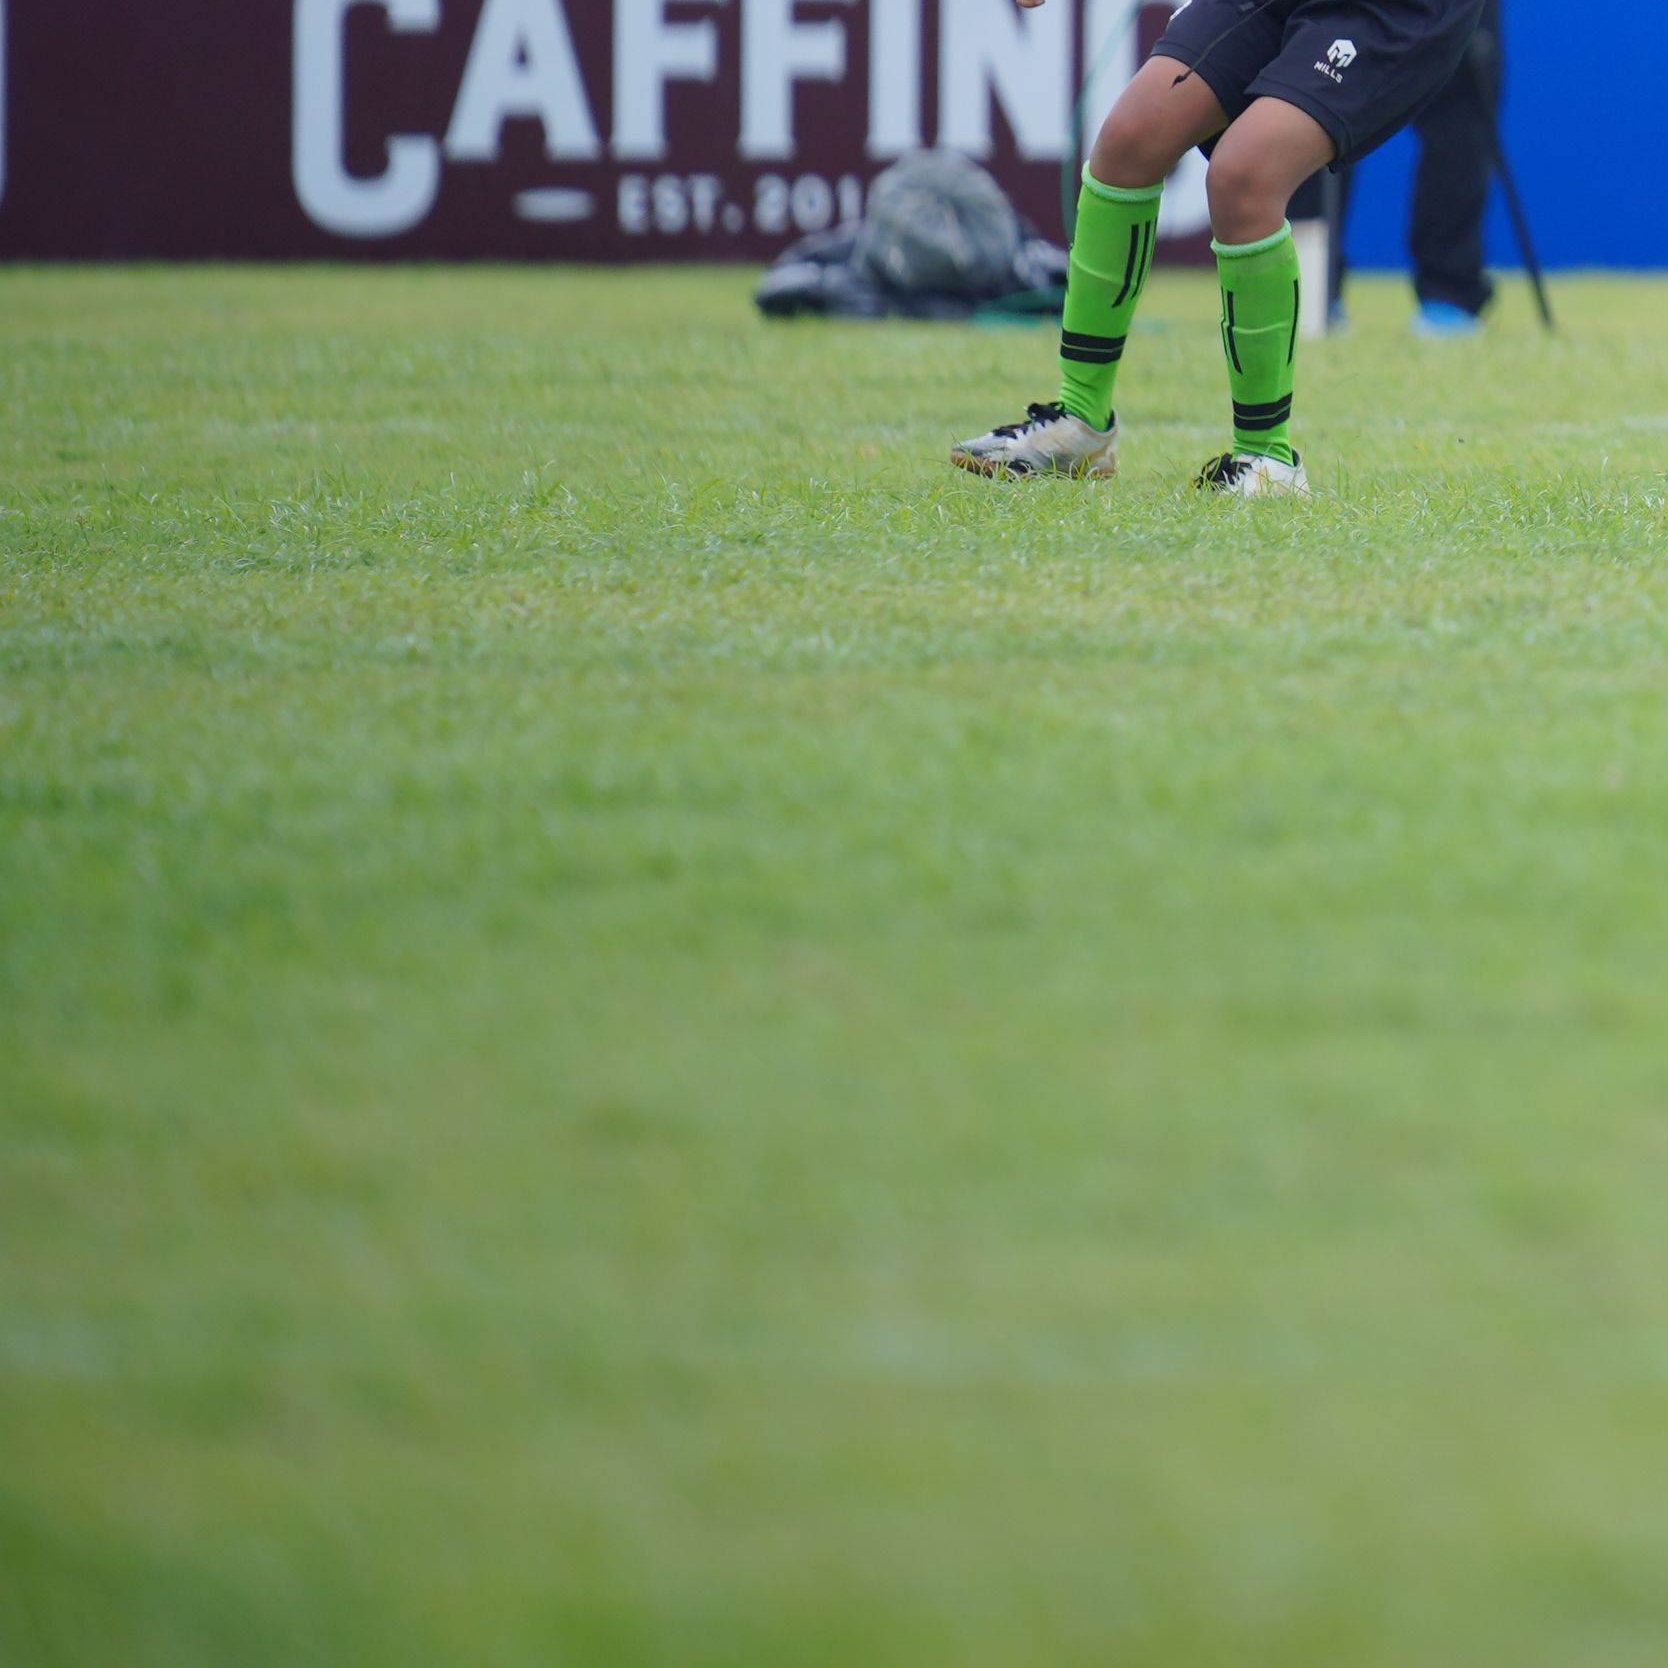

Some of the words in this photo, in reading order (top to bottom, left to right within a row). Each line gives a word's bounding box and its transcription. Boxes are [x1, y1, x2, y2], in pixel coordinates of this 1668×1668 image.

[1313, 61, 1344, 83] MILLS
[617, 173, 746, 233] EST.
[753, 173, 868, 233] 201
